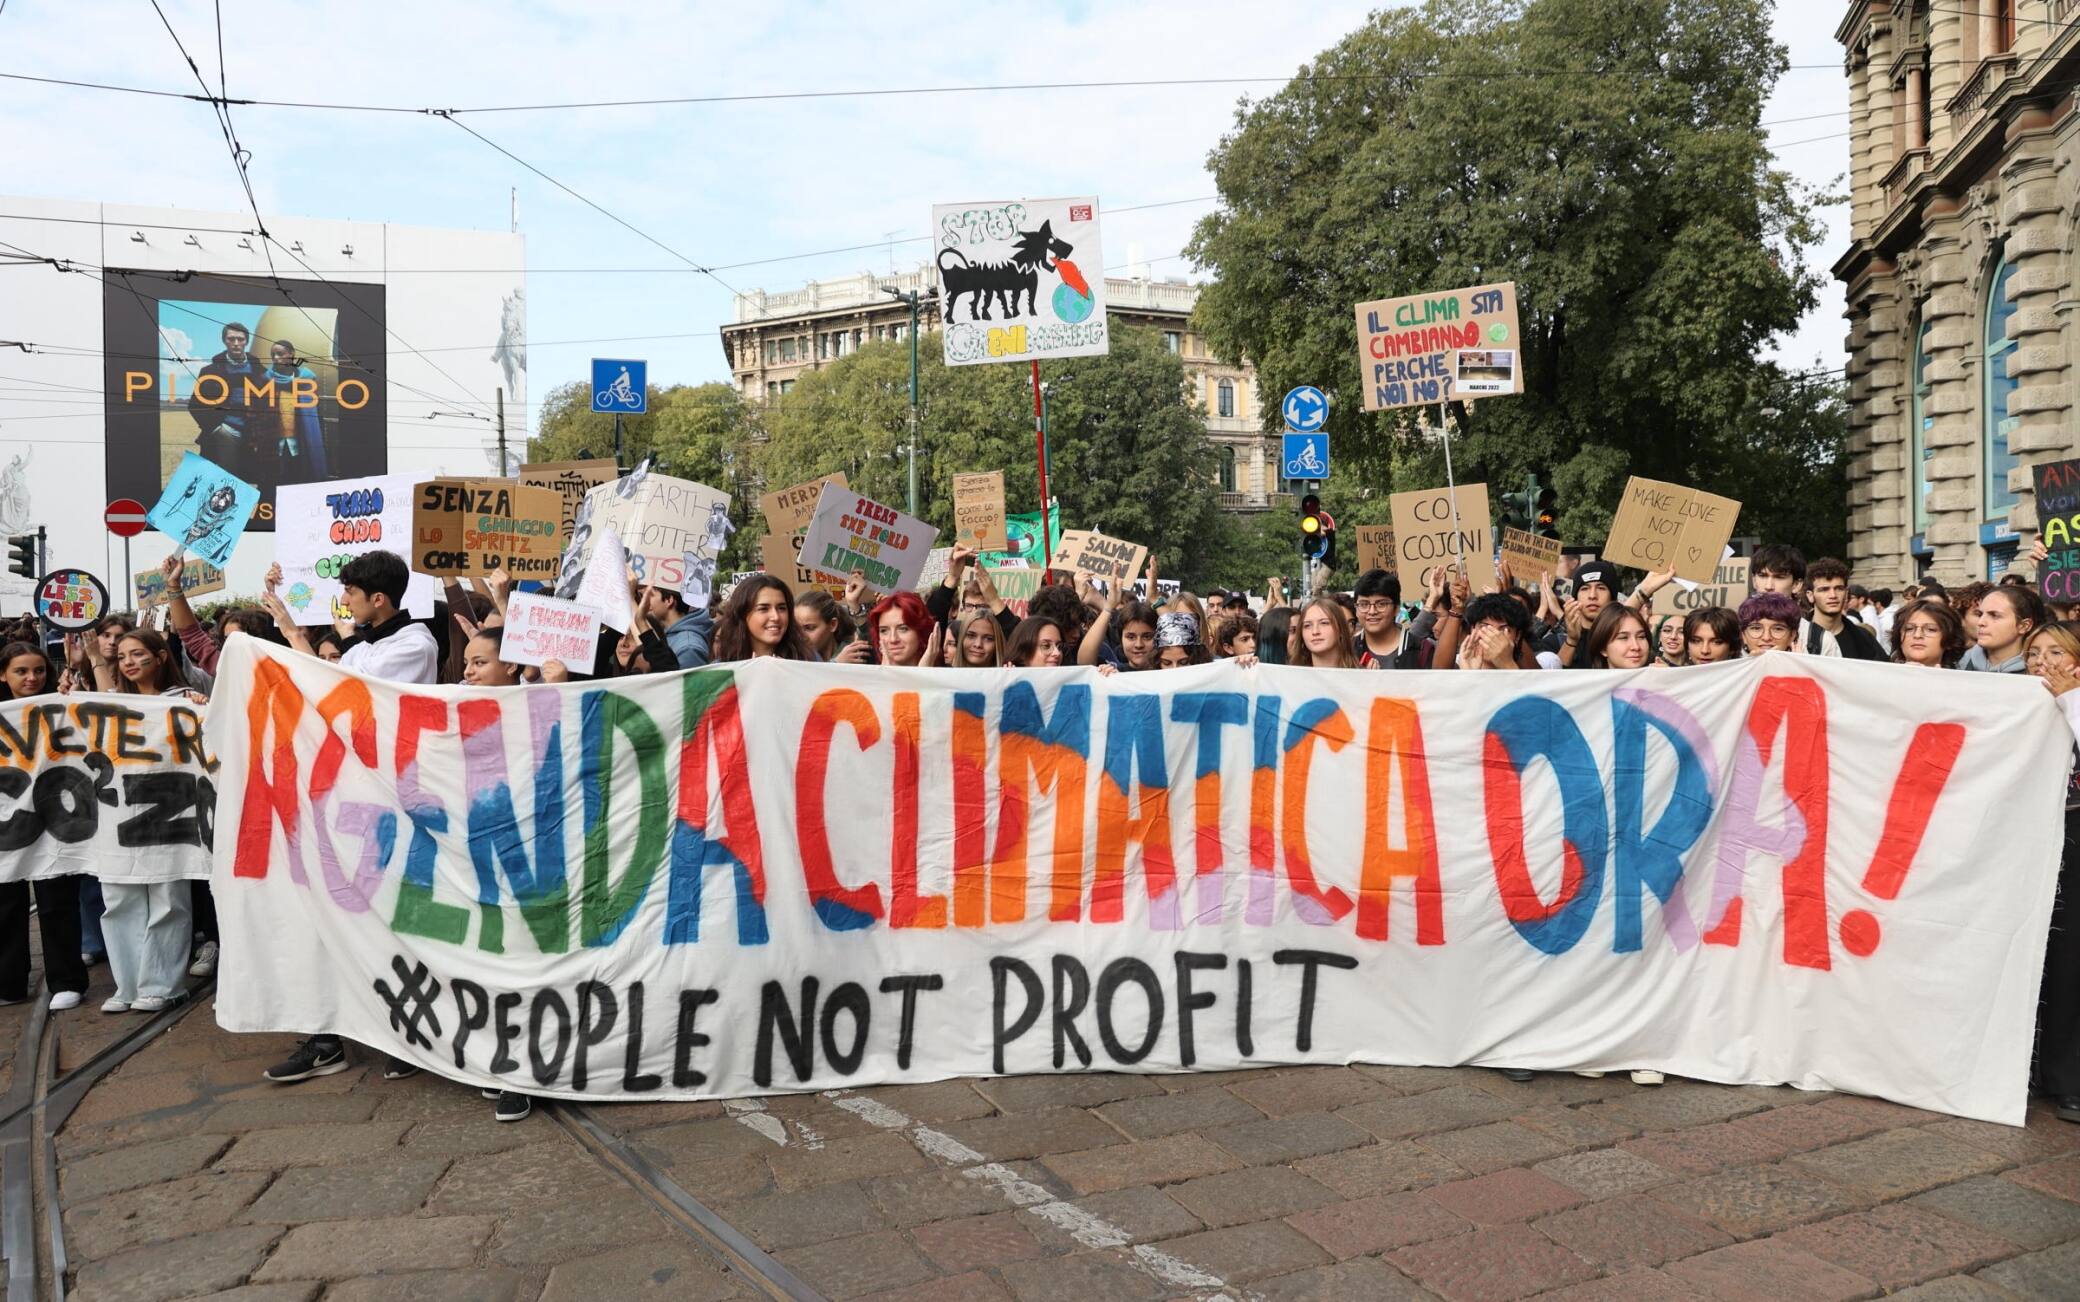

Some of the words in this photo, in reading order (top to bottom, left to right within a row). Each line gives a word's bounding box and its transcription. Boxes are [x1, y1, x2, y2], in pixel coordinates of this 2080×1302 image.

[941, 203, 1027, 249] STOP
[1367, 311, 1389, 334] IL
[1395, 296, 1460, 327] CLIMA
[1471, 289, 1504, 315] STA
[1369, 320, 1482, 360] CAMBIANDO,
[125, 371, 370, 410] PIOMBO
[1376, 383, 1408, 408] NOI
[326, 487, 384, 519] TERRA
[422, 485, 511, 518] SENZA
[592, 486, 621, 513] THE
[634, 480, 713, 518] EARTH
[777, 482, 826, 510] MERD
[855, 498, 898, 526] TREAT
[1632, 487, 1677, 512] MAKE
[1678, 499, 1720, 523] LOVE
[420, 527, 444, 544] LO
[464, 529, 533, 554] SPRITZ
[478, 516, 556, 537] GHIACCIO
[621, 519, 710, 557] HOTTER
[868, 524, 910, 551] WORLD
[1647, 516, 1684, 537] NOT
[848, 534, 881, 559] WITH
[423, 550, 471, 570] COME
[482, 553, 501, 570] LO
[507, 557, 560, 576] FACCIO?
[632, 554, 684, 588] BTS
[797, 569, 812, 583] LE
[820, 542, 902, 589] KINDNESS
[1711, 565, 1746, 585] ALLE
[40, 599, 97, 620] PAPER
[0, 702, 163, 773] VETE
[166, 703, 221, 775] R
[233, 656, 770, 955] AGENDA
[794, 680, 1446, 947] CLIMATICA
[1482, 675, 1967, 972] ORA!
[373, 953, 718, 1092] #PEOPLE
[753, 974, 944, 1088] NOT
[989, 948, 1360, 1075] PROFIT
